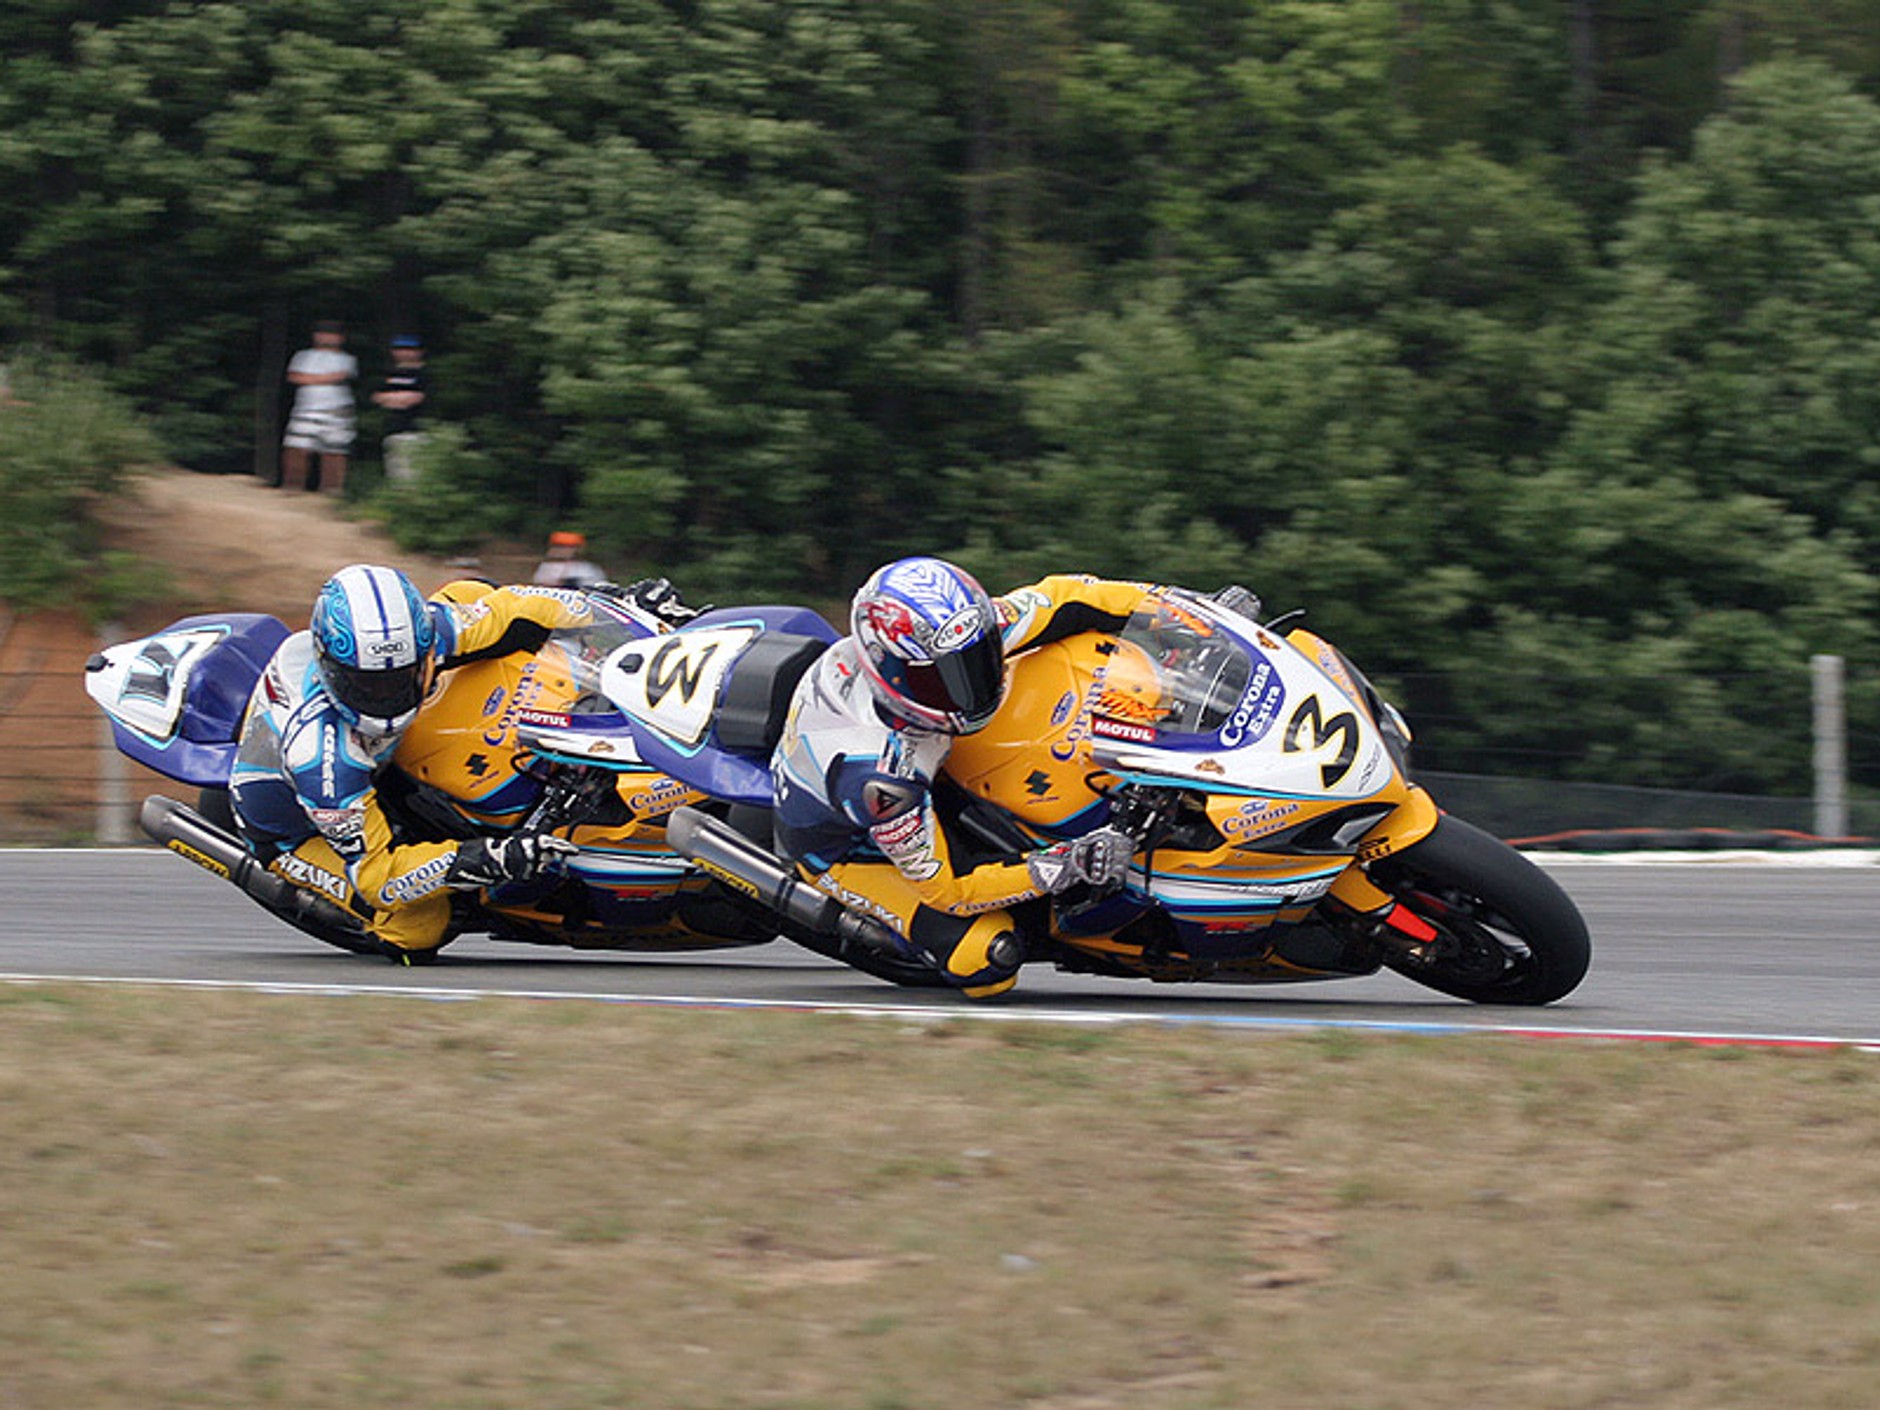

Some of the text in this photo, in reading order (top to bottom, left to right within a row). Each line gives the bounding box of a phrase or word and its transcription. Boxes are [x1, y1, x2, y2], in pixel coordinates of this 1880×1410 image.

[646, 636, 720, 708] 3
[518, 710, 570, 728] MOTUL
[1050, 666, 1108, 762] Corona
[1095, 720, 1154, 741] MOTUL
[1220, 662, 1271, 747] Corona
[1246, 685, 1281, 735] Extra
[1281, 692, 1361, 790] 3
[1222, 803, 1299, 834] Corona
[379, 851, 458, 905] Corona
